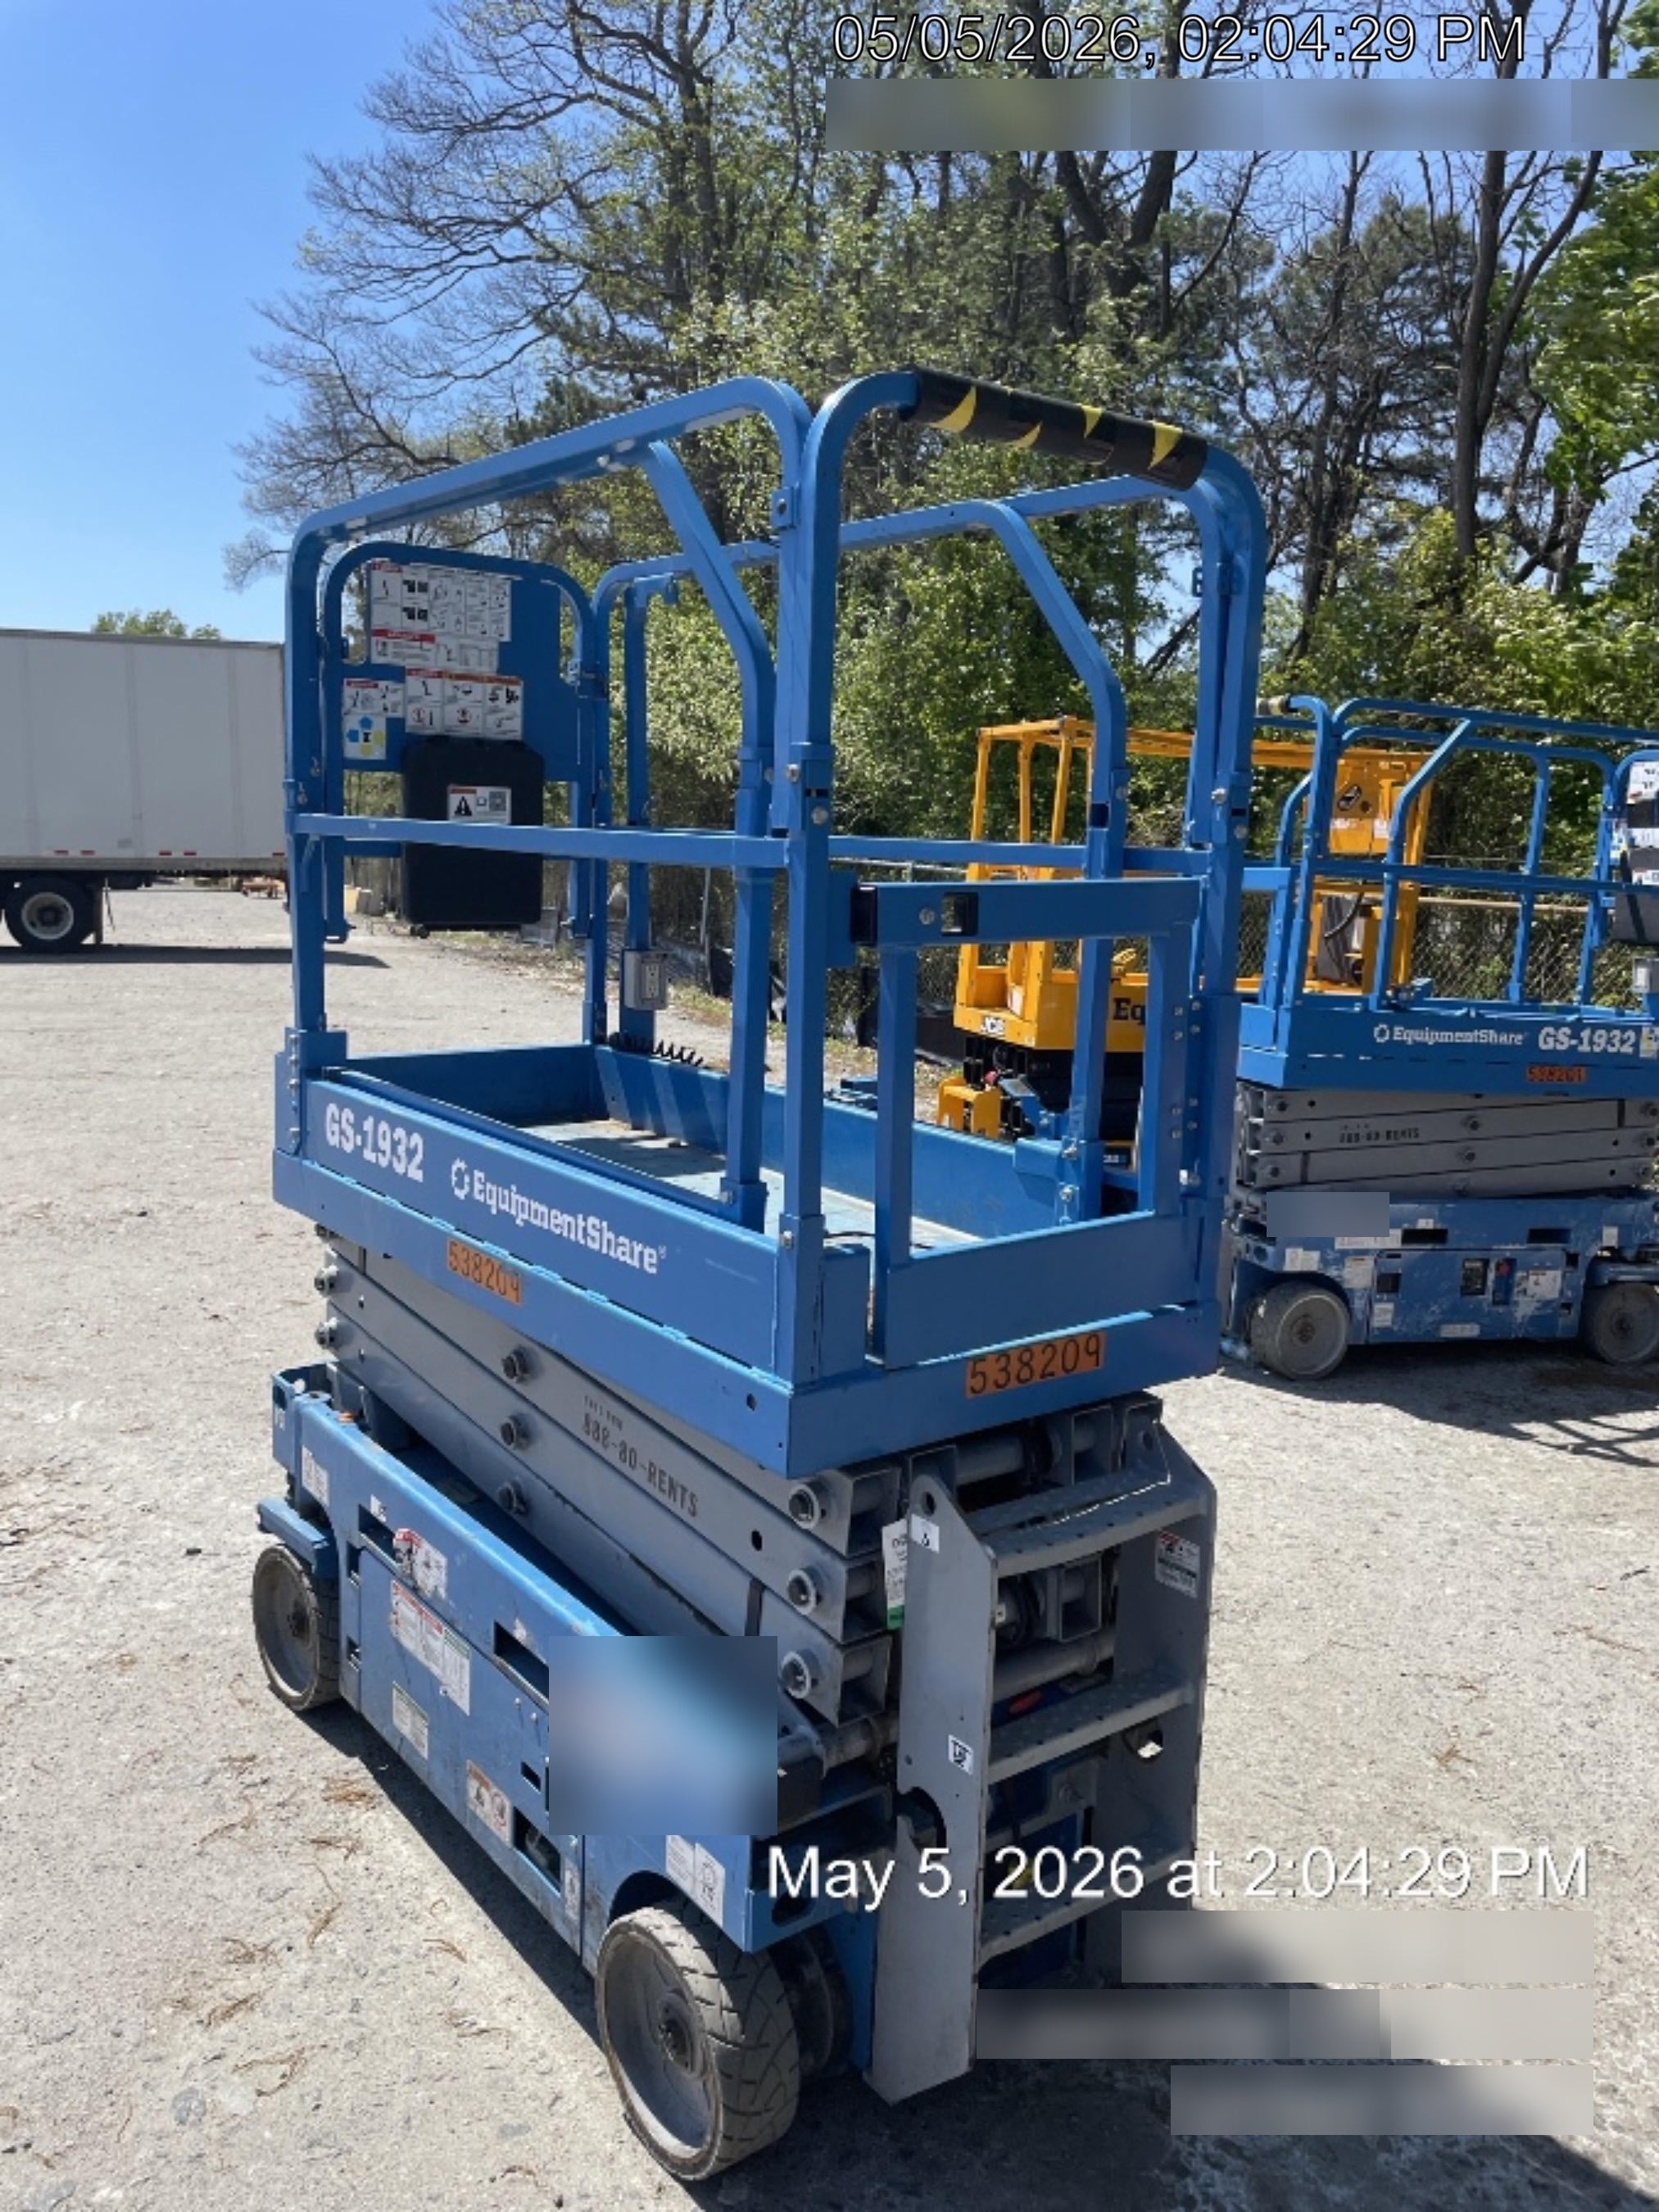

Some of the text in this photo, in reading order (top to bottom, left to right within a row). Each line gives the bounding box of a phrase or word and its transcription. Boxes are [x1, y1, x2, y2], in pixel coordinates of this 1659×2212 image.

[1393, 1026, 1524, 1045] EquipmentShare
[1538, 1027, 1636, 1054] GS-1932
[326, 1103, 424, 1182] GS-1932
[473, 1169, 658, 1274] EquipmentShare
[970, 1333, 1100, 1394] 538209
